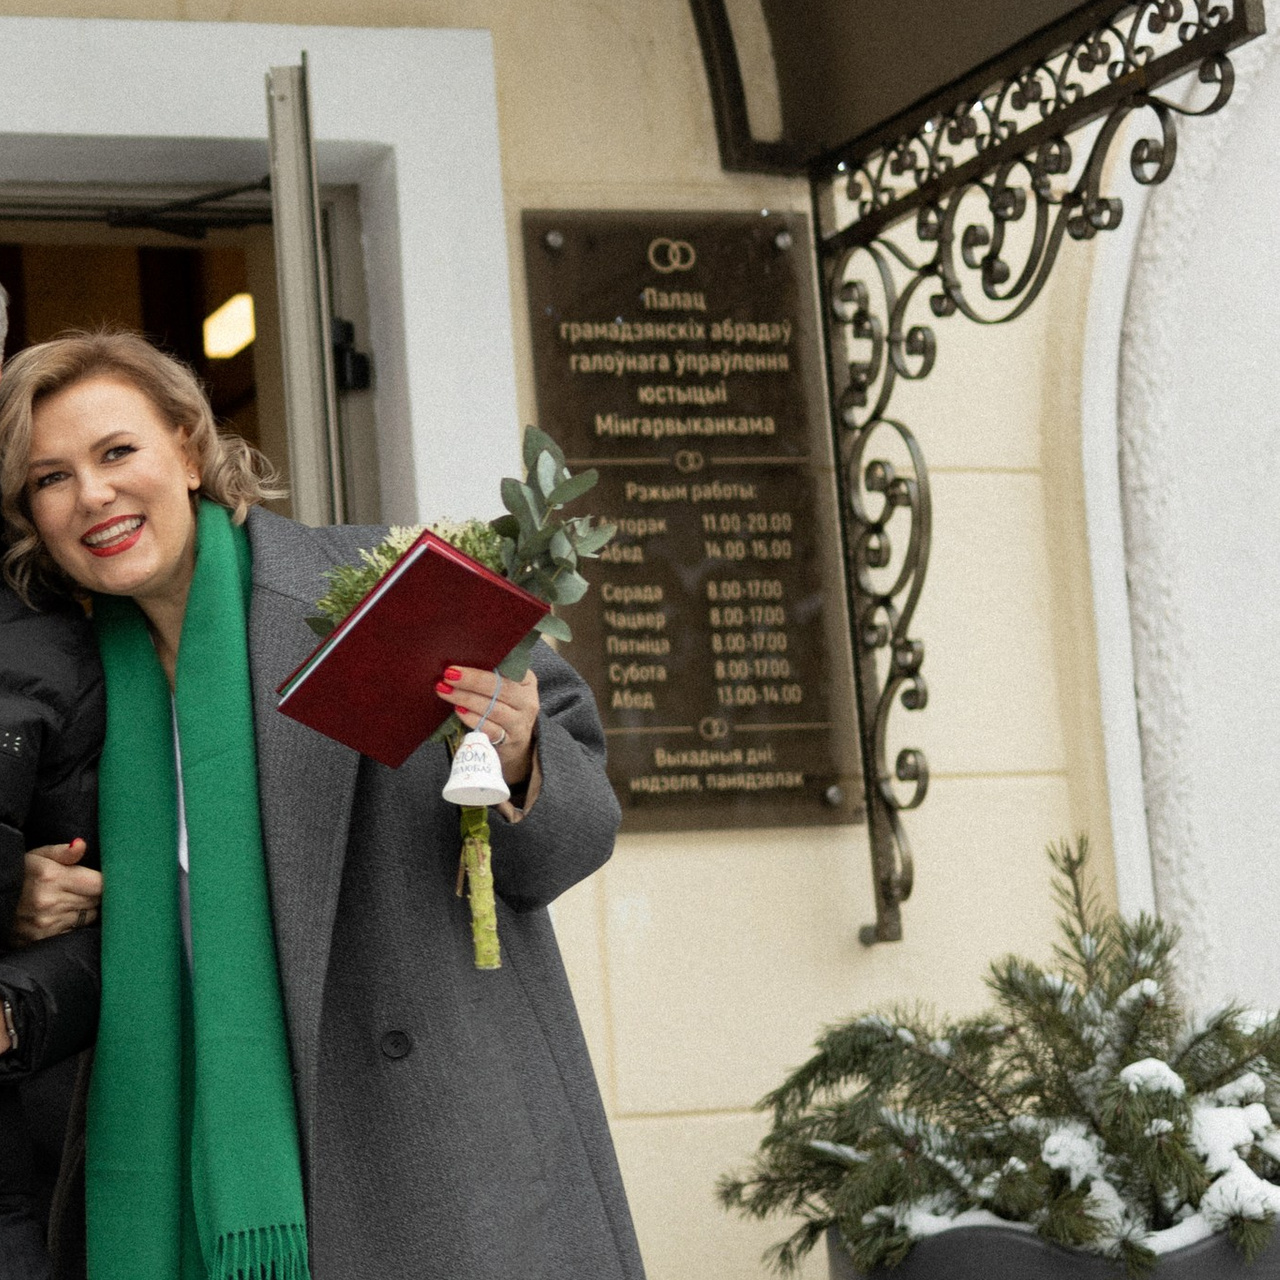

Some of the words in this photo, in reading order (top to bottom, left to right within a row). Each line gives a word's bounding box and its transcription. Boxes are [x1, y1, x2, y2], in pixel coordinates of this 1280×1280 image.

[644, 286, 707, 311] Палац
[560, 318, 705, 344] грамадзянскіх
[570, 351, 670, 376] галоўнага
[637, 379, 727, 406] юстыцыі
[595, 413, 776, 440] Мінгарвыканкама
[702, 512, 792, 532] 11.00-20.00
[601, 582, 663, 604] Серада
[707, 580, 783, 600] 8.00-17.00
[609, 661, 667, 684] Субота
[612, 689, 655, 709] Абед
